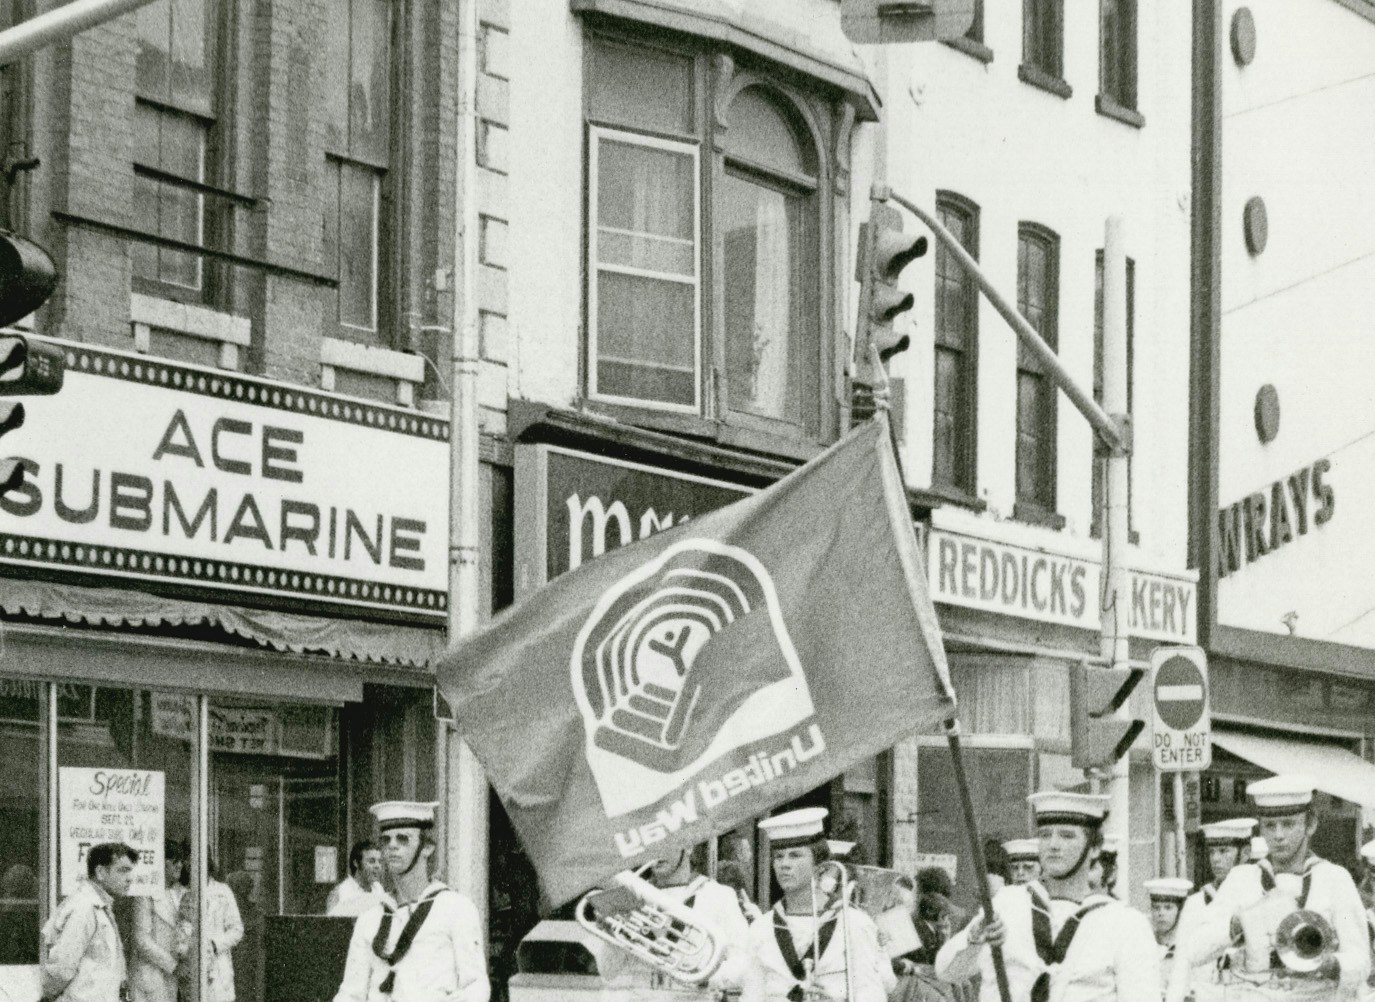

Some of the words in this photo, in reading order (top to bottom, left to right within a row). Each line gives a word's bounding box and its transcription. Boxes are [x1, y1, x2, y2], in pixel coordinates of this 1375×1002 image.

[152, 408, 304, 484] ACE
[0, 456, 427, 571] SUBMARINE
[1218, 458, 1335, 579] WRAYS
[938, 537, 1087, 619] REDDICK'S
[1128, 576, 1191, 636] KERY
[1154, 732, 1172, 748] DO
[1184, 732, 1208, 749] NOT
[1161, 748, 1204, 764] ENTER
[89, 770, 152, 799] Special
